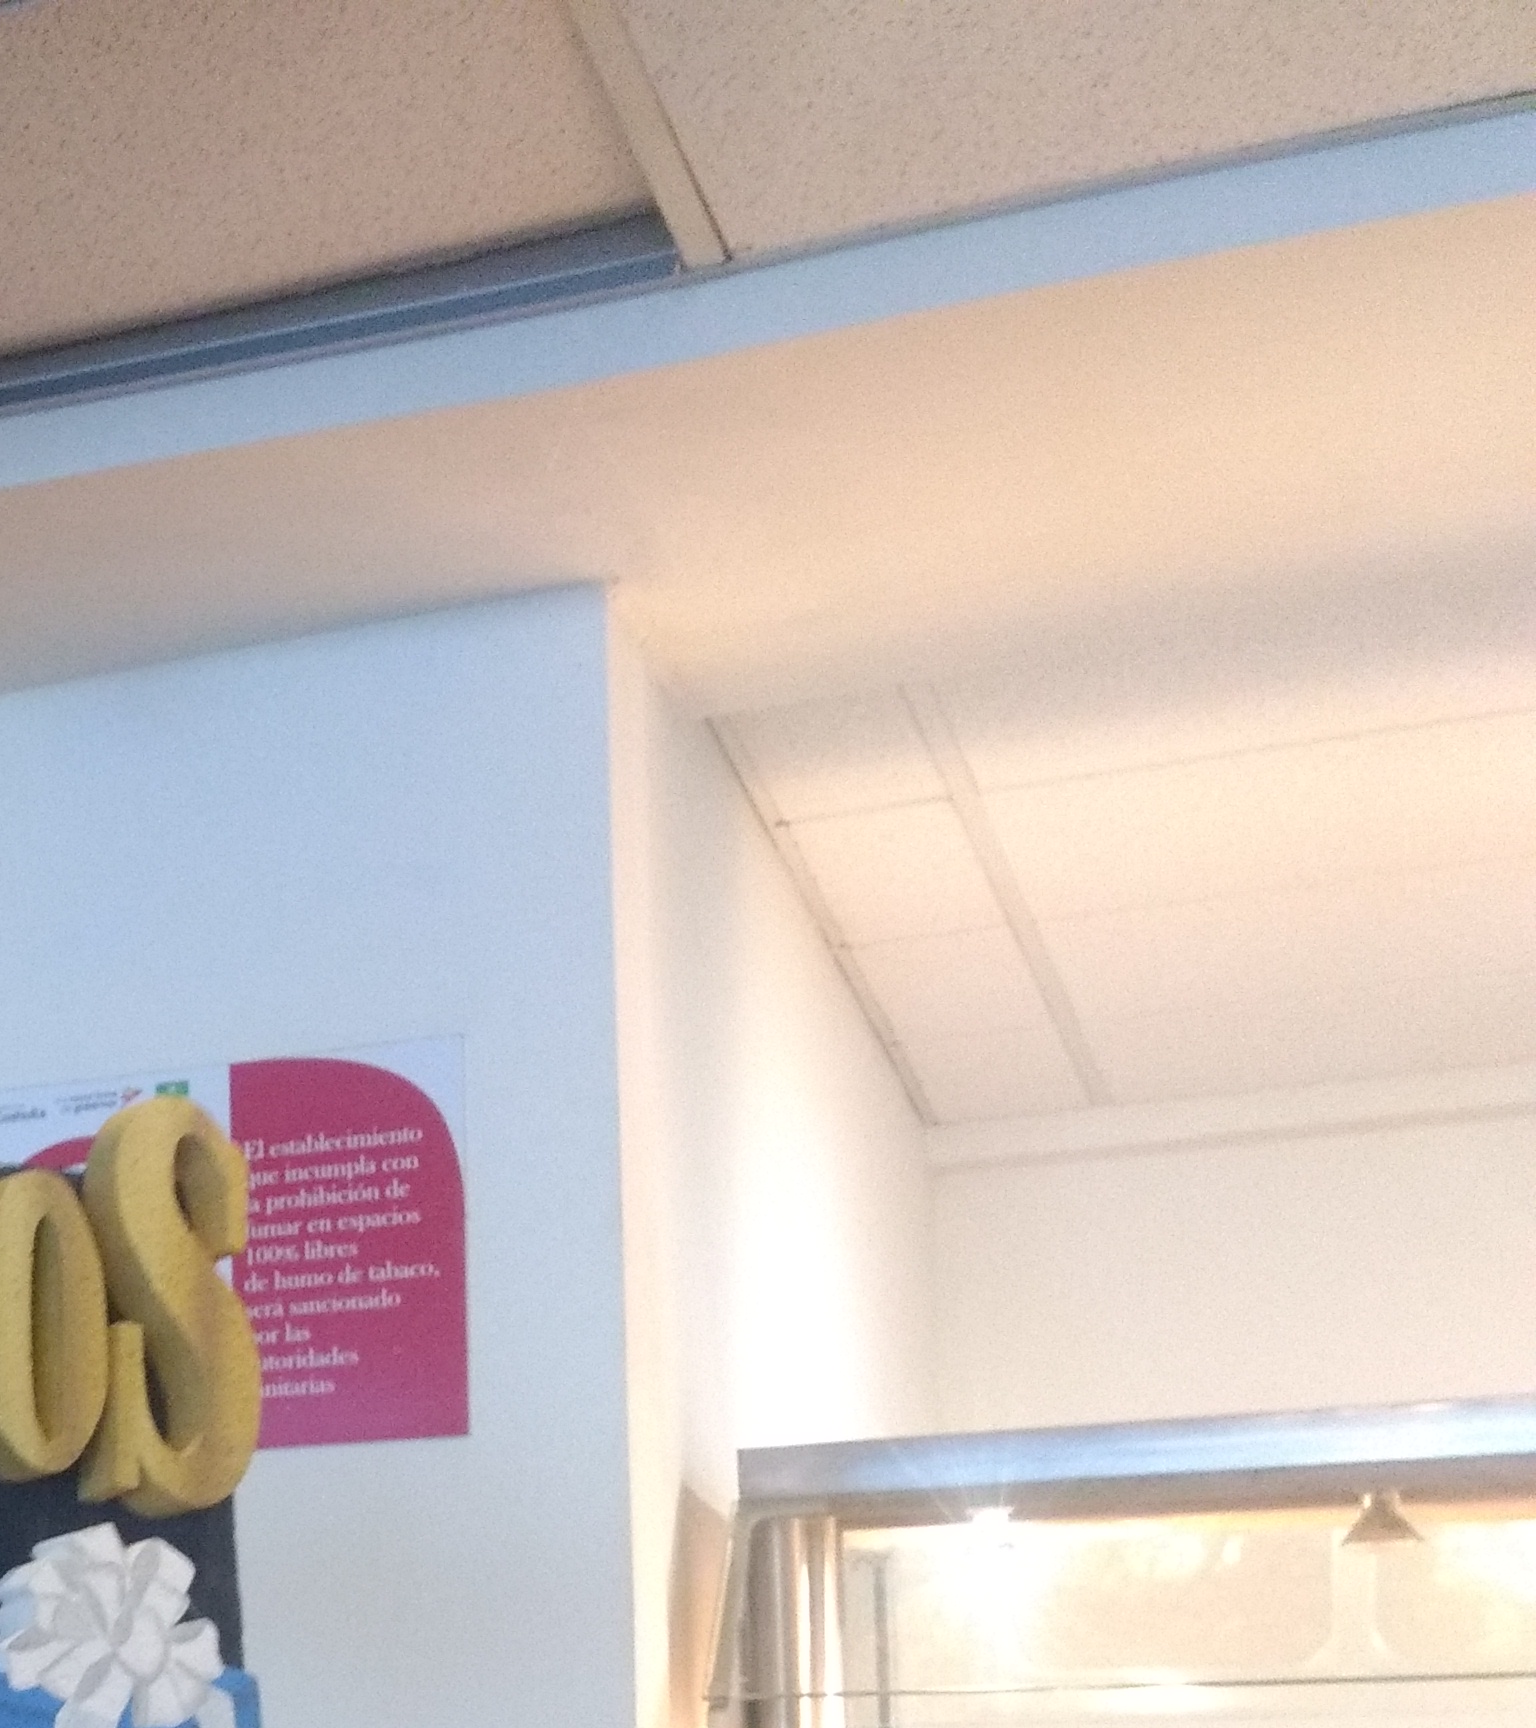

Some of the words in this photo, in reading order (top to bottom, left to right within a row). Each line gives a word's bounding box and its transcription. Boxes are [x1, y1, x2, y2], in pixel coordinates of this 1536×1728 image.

[244, 1138, 265, 1161] El
[269, 1127, 424, 1158] establecimiento
[284, 1154, 377, 1184] incumpla
[382, 1154, 420, 1173] con
[266, 1180, 380, 1216] prohibición
[385, 1177, 411, 1199] de
[248, 1221, 302, 1239] umar
[307, 1216, 332, 1233] en
[337, 1205, 422, 1233] espacios
[247, 1245, 299, 1266] 100%
[304, 1239, 359, 1261] libres
[243, 1270, 269, 1293] de
[274, 1269, 334, 1290] humo
[337, 1262, 363, 1285] de
[368, 1260, 441, 1282] tabaco,
[288, 1286, 402, 1317] sancionado
[285, 1321, 311, 1343] las
